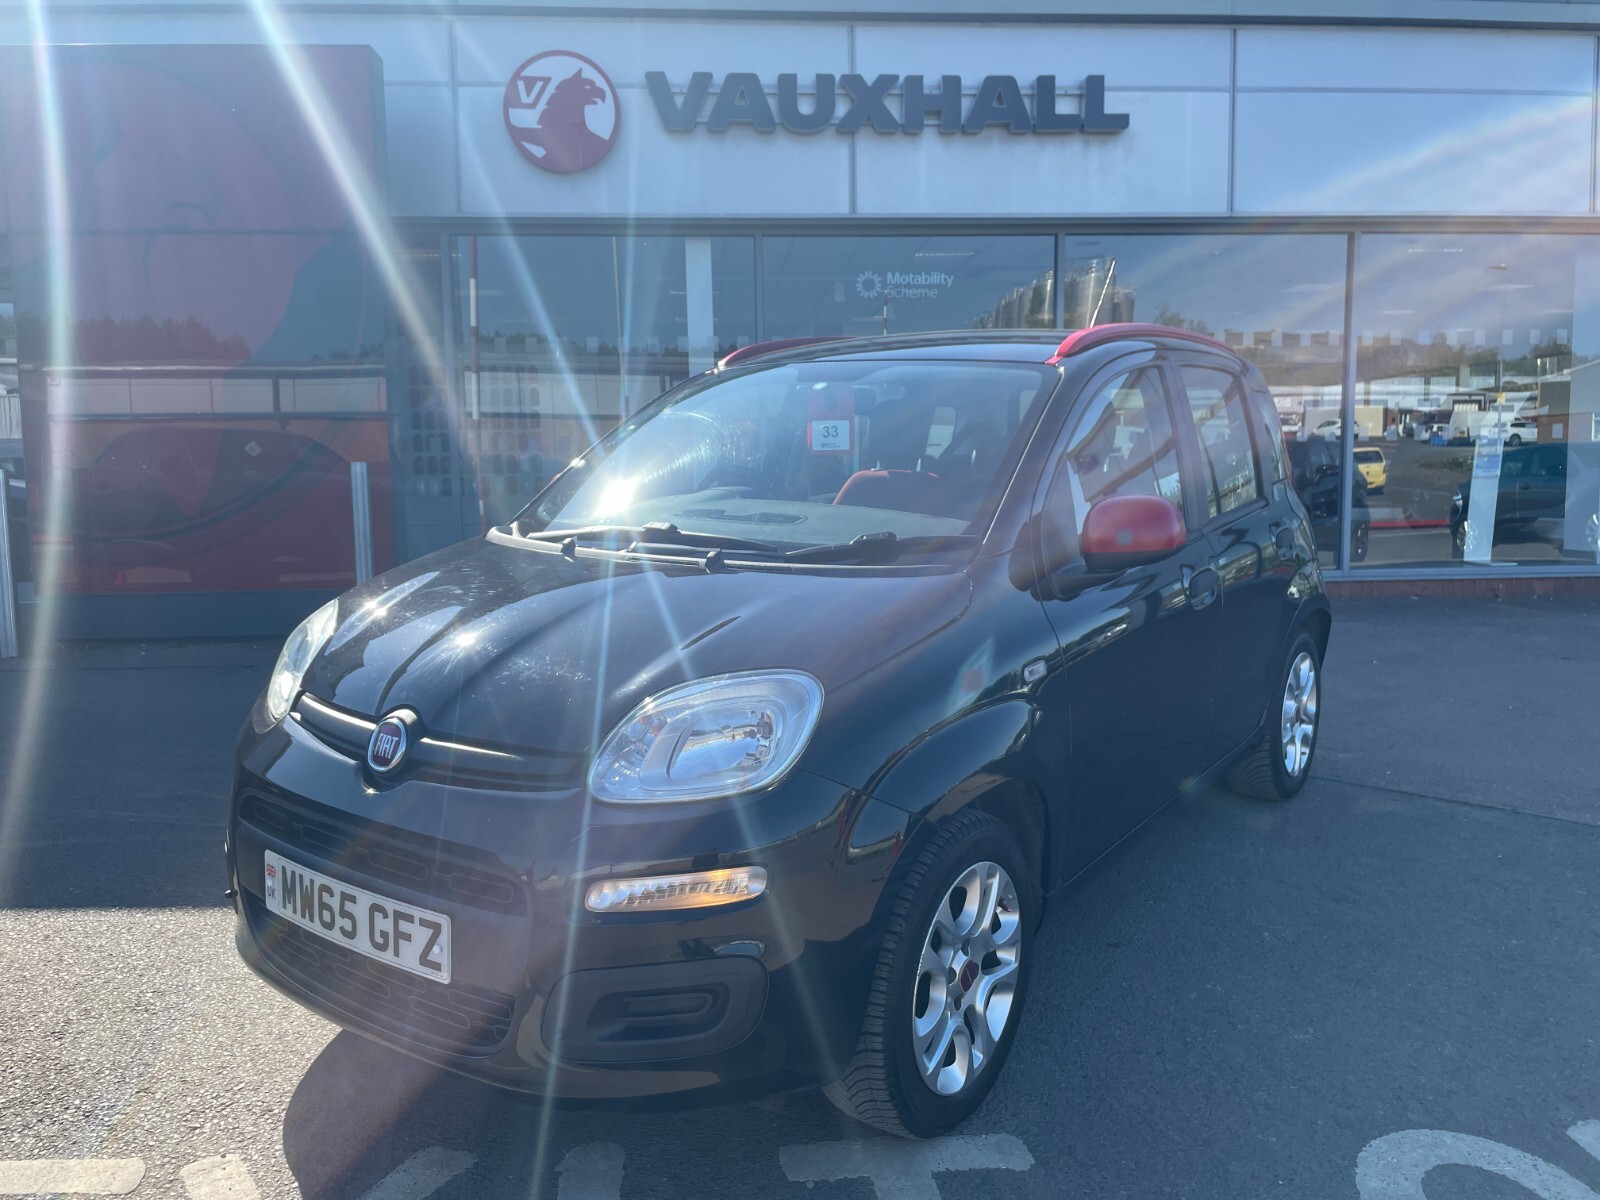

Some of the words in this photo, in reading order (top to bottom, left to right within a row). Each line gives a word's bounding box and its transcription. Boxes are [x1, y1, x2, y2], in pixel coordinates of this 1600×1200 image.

[644, 71, 1130, 135] VAUXHALL
[886, 271, 954, 288] Motability
[886, 285, 938, 298] Scheme
[822, 425, 839, 438] 33
[374, 732, 400, 760] FIAT
[267, 885, 276, 899] UK
[281, 865, 358, 941] MW65
[368, 902, 442, 972] GFZ
